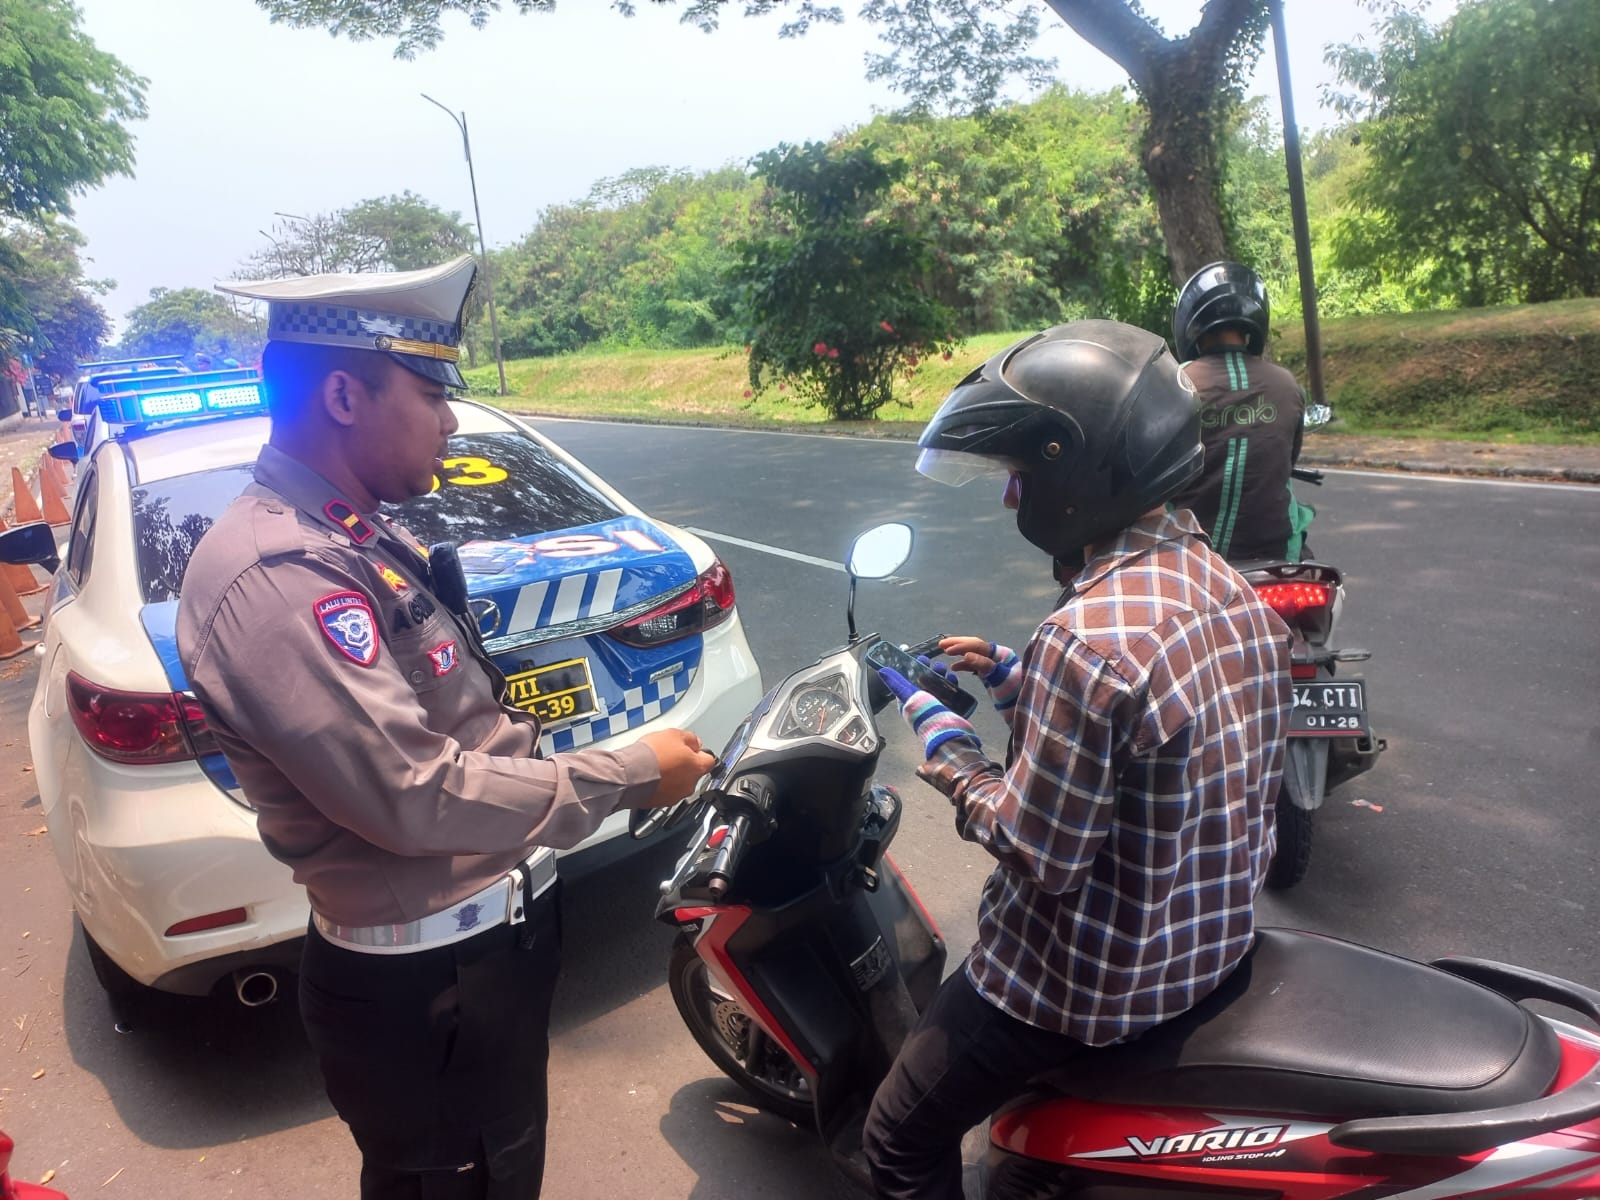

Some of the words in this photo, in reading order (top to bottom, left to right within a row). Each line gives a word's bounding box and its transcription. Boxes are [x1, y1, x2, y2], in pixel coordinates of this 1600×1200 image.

[1200, 392, 1278, 428] Grab
[1323, 688, 1357, 708] CTI
[1126, 1126, 1285, 1157] VARIO
[1202, 1154, 1233, 1162] IDLING
[1234, 1152, 1264, 1160] STOP
